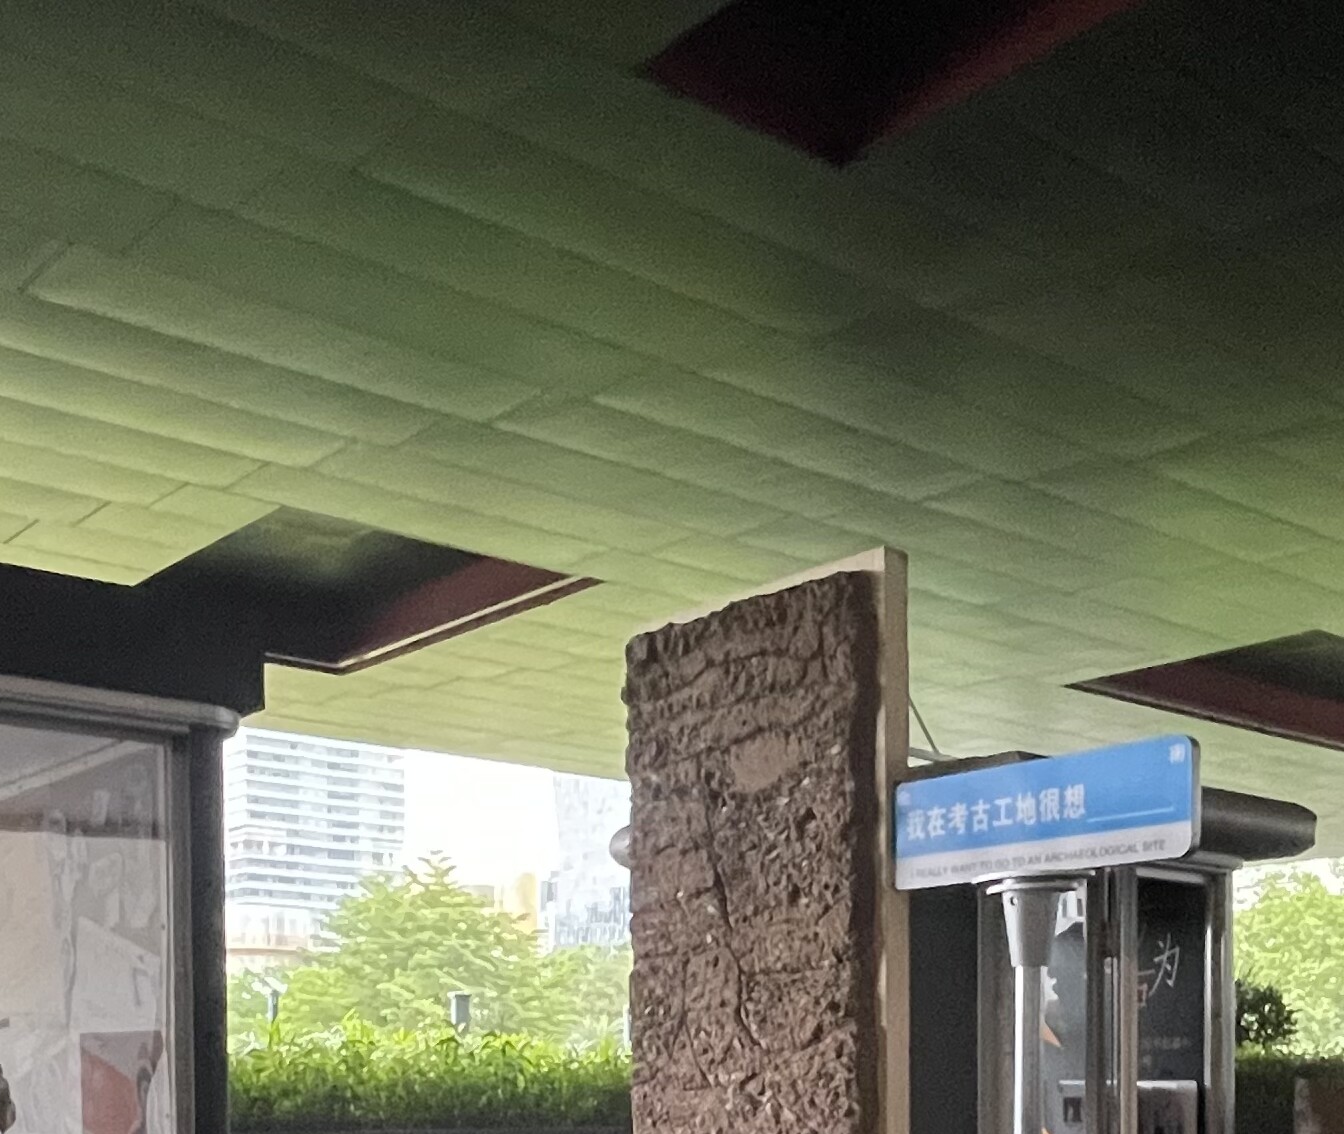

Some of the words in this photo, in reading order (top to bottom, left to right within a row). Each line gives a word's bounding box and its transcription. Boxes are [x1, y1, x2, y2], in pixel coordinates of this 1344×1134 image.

[907, 783, 1086, 841] 我在考古工地很想
[951, 861, 977, 874] WANT
[978, 859, 993, 871] TO
[995, 857, 1010, 869] GO
[1012, 856, 1026, 867] TO
[1027, 853, 1042, 865] AN
[1044, 842, 1139, 863] ARCHAEOLOGICAL
[1142, 838, 1166, 853] SITE
